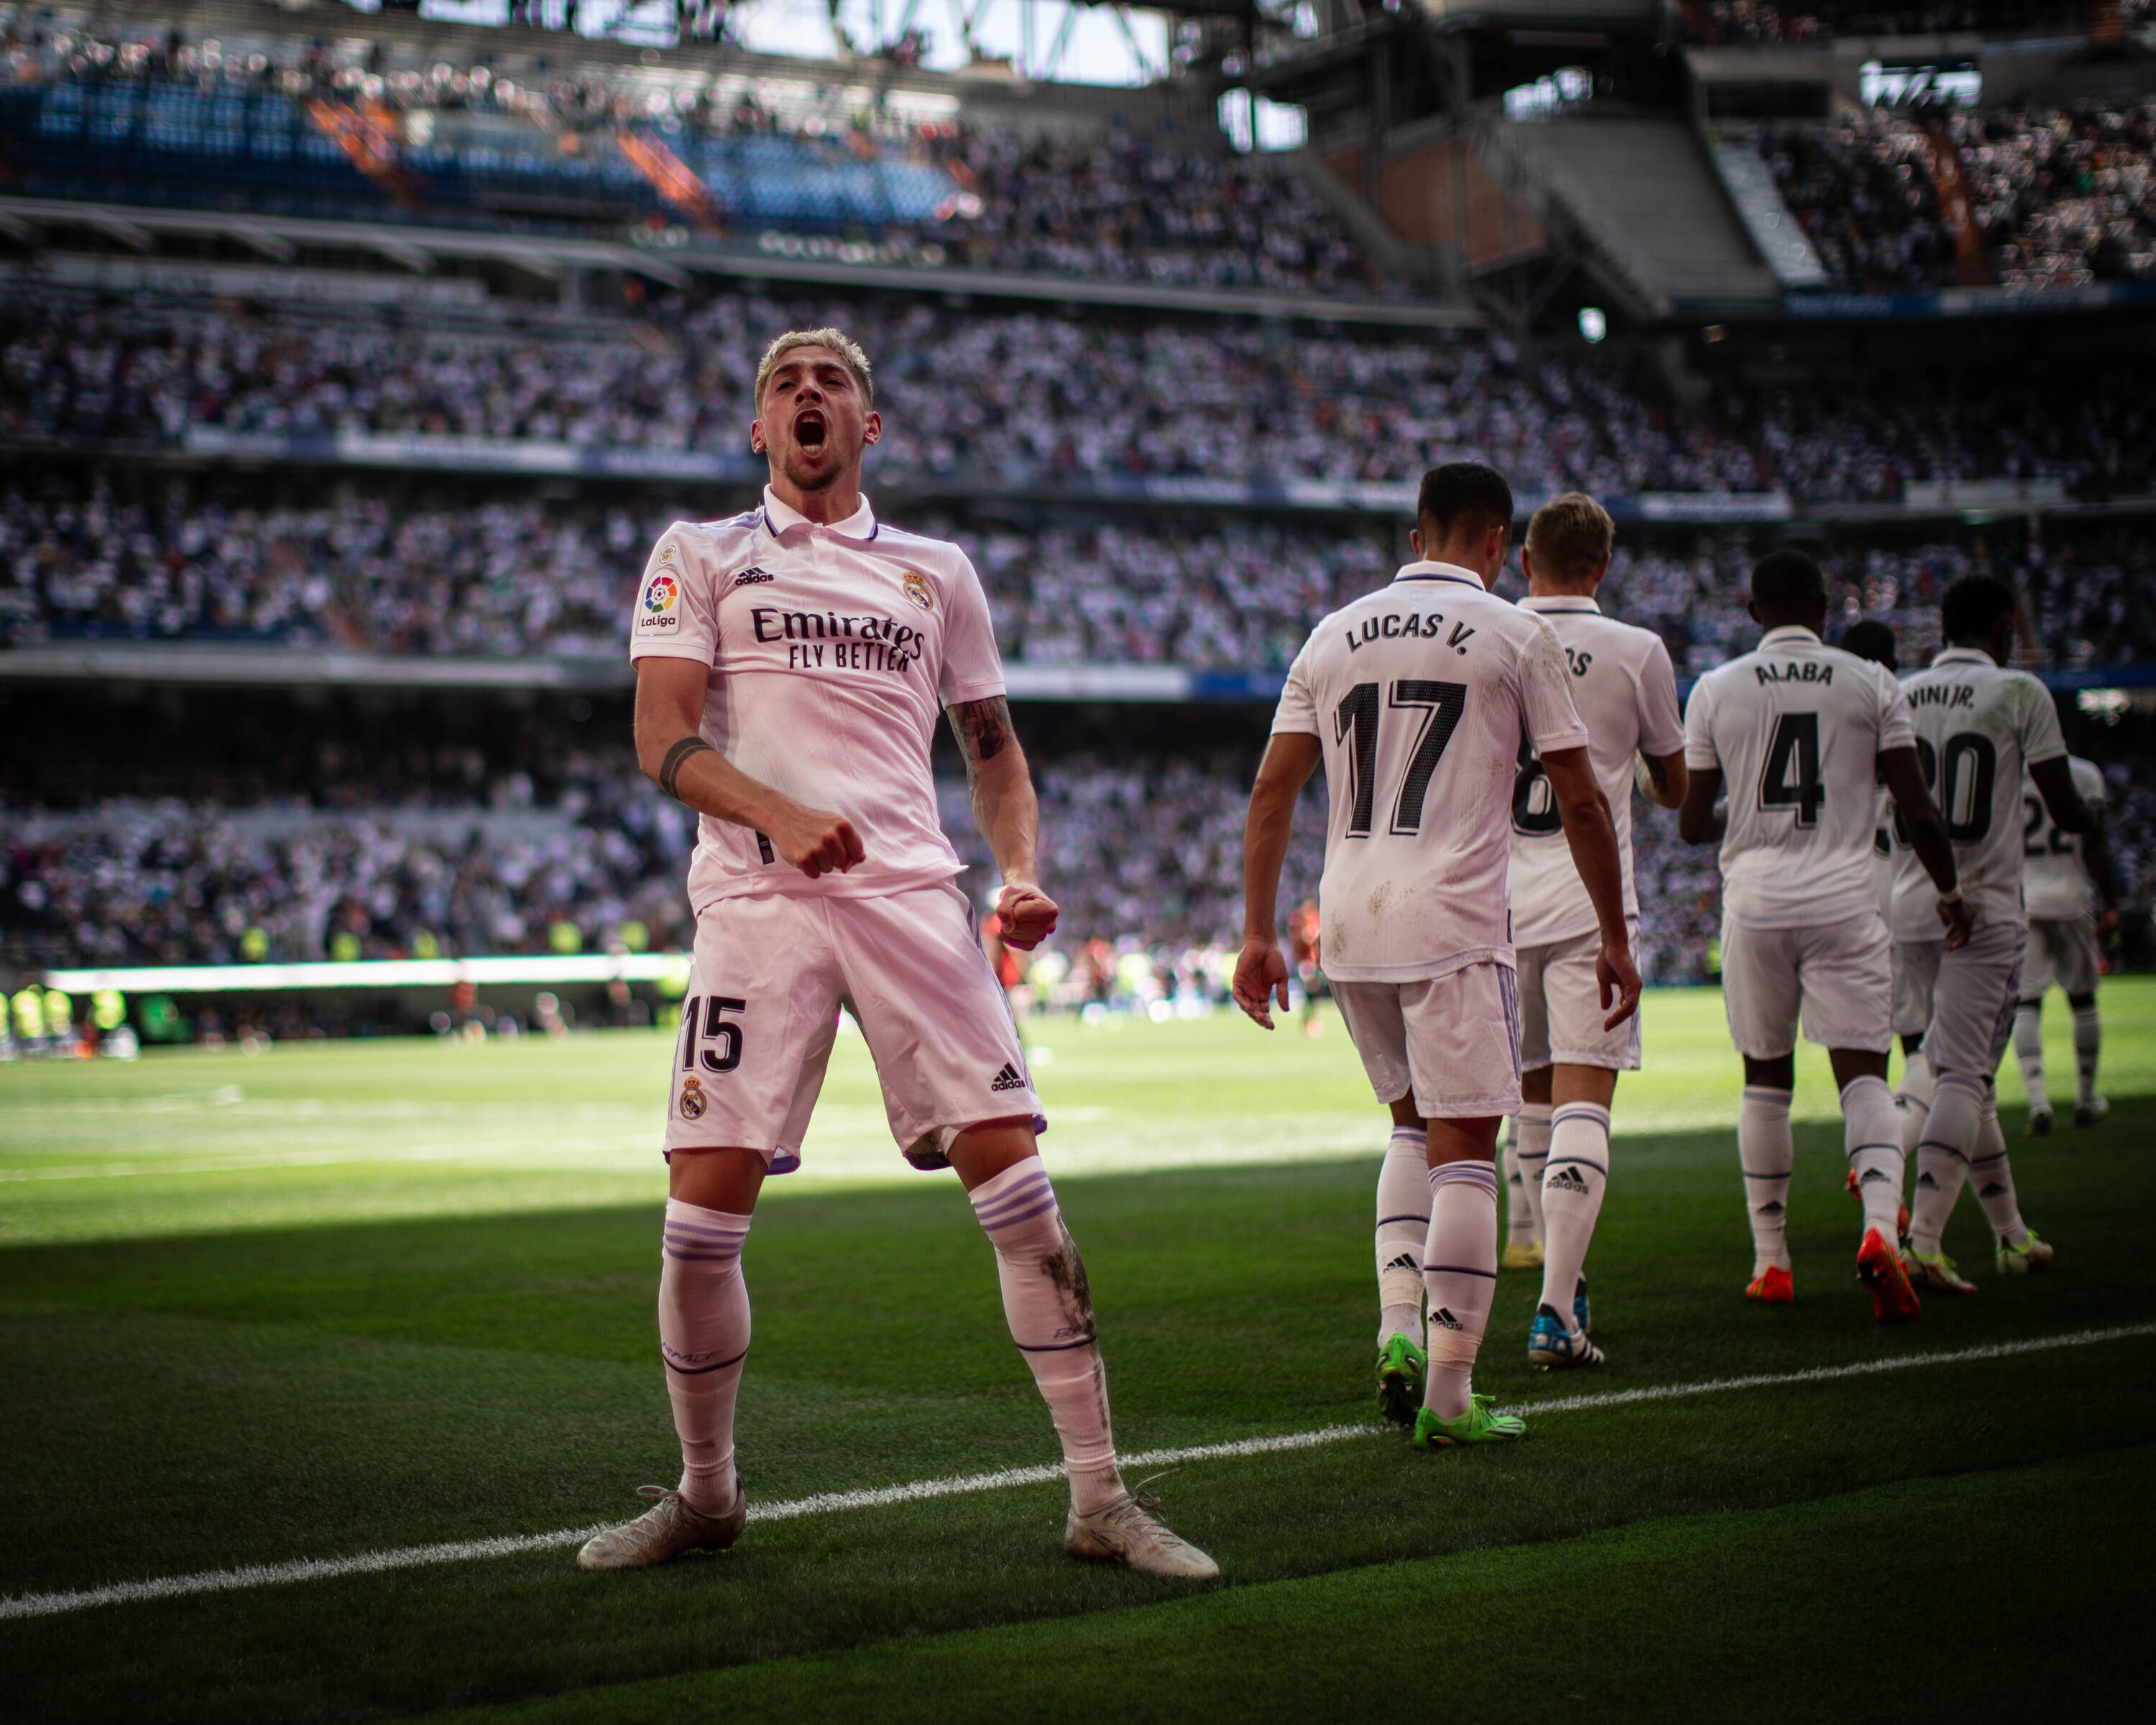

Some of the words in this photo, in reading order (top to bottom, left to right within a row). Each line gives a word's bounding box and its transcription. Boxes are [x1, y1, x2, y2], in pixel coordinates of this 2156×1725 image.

[735, 574, 774, 586] adidas
[641, 615, 676, 627] LaLiga
[750, 608, 925, 661] Emirates
[1345, 613, 1444, 653] LUCAS
[1446, 620, 1475, 656] V.
[789, 644, 824, 669] FLY
[835, 643, 910, 673] BETTER
[1755, 661, 1834, 686] ALABA
[1333, 679, 1468, 839] 17
[1757, 711, 1825, 830] 4
[680, 995, 747, 1073] 15
[991, 1080, 1026, 1092] adidas
